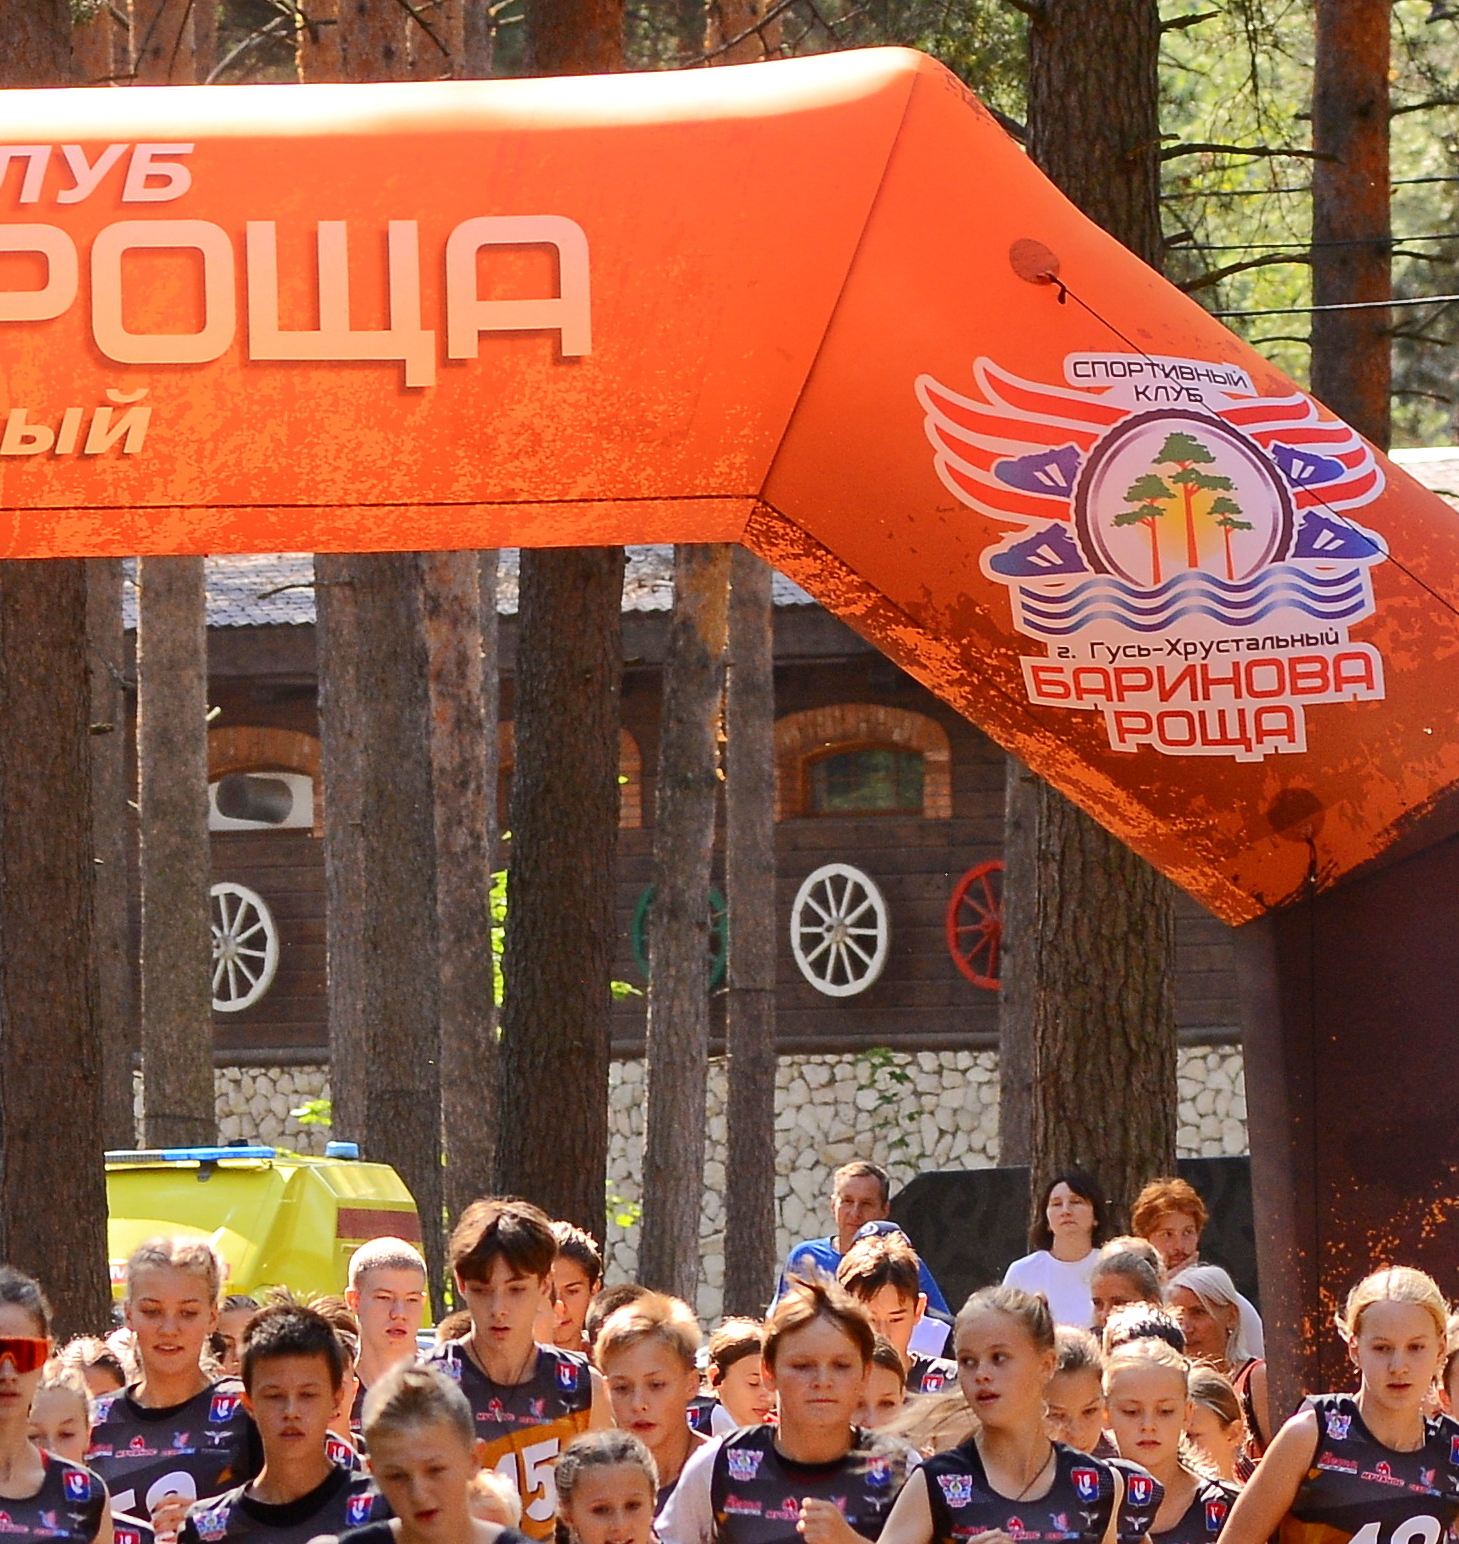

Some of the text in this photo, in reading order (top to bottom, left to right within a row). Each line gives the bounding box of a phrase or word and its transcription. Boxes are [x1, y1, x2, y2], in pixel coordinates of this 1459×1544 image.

[1073, 361, 1248, 388] СПОРТИВНЫЙ
[1134, 385, 1203, 403] КЛУБ
[1090, 626, 1340, 665] Гусь-Хрустальный
[1030, 650, 1376, 702] БАРИНОВА
[1113, 704, 1297, 752] РОЩА
